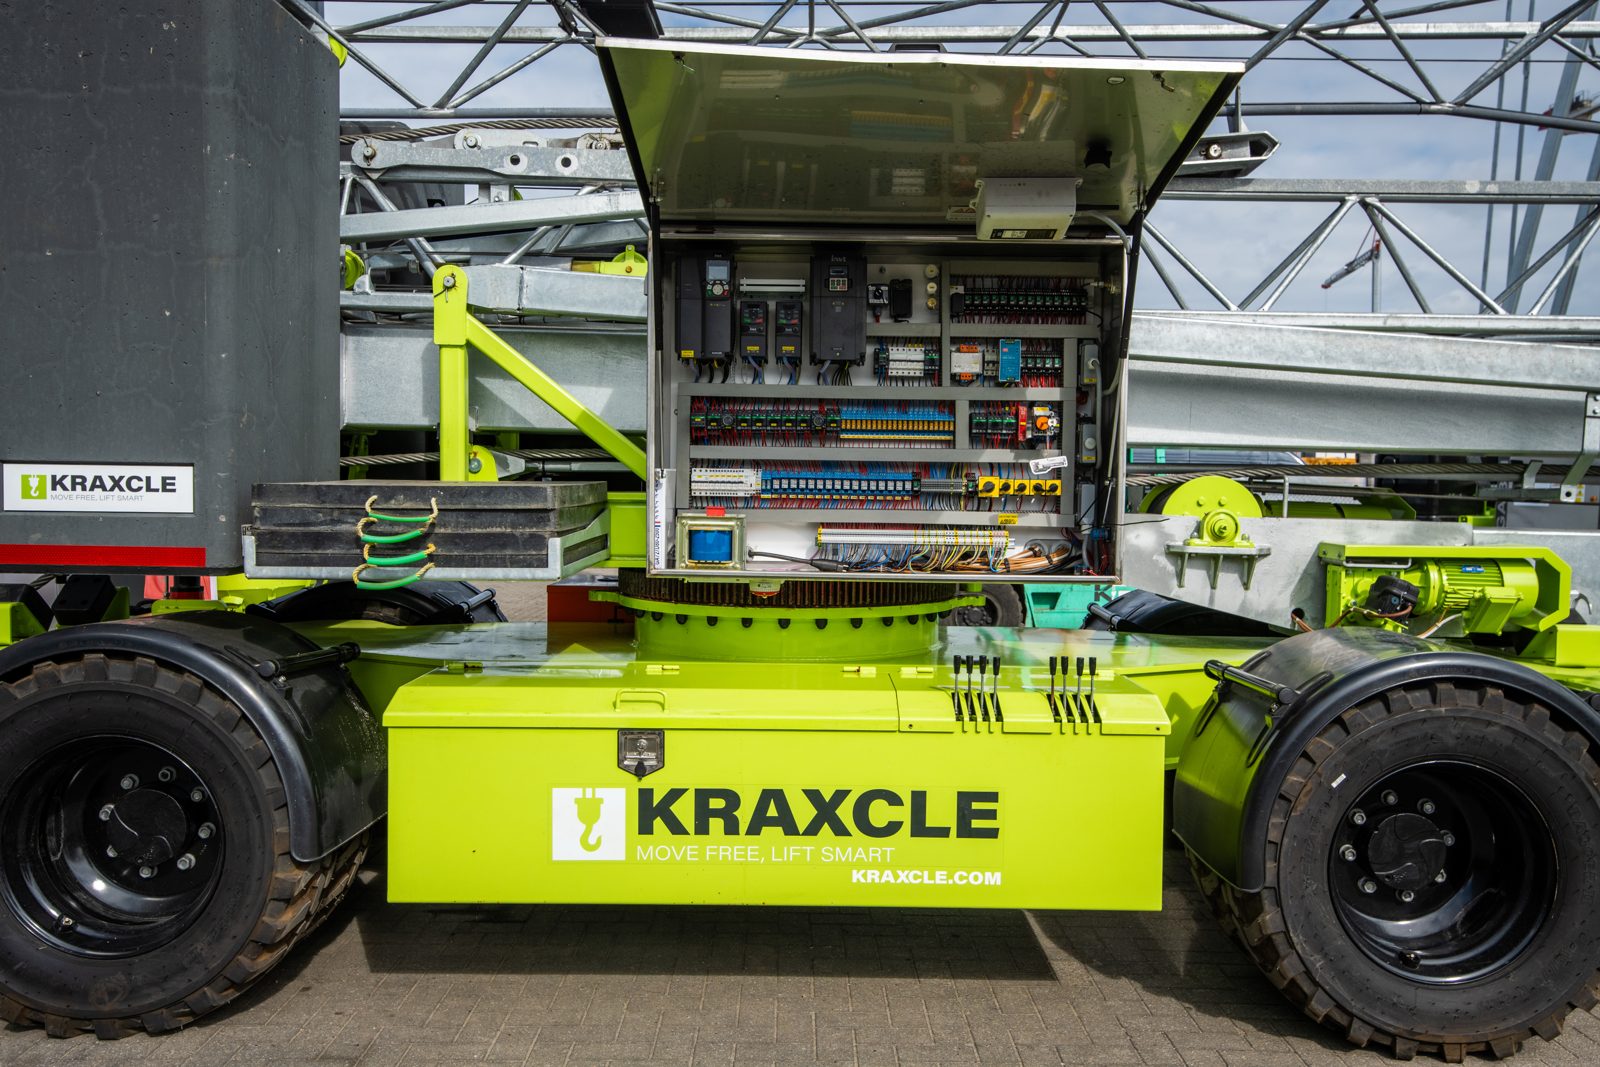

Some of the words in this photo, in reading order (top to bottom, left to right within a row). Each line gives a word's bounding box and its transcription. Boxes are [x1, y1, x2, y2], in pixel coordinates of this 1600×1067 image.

[51, 474, 177, 492] KRAXCLE
[76, 494, 98, 502] FREE,
[637, 788, 1000, 838] KRAXCLE
[636, 845, 700, 862] MOVE
[705, 845, 766, 864] FREE,
[771, 846, 815, 863] LIFT
[821, 846, 895, 863] SMART
[851, 869, 1002, 886] KRAXCLE.COM
